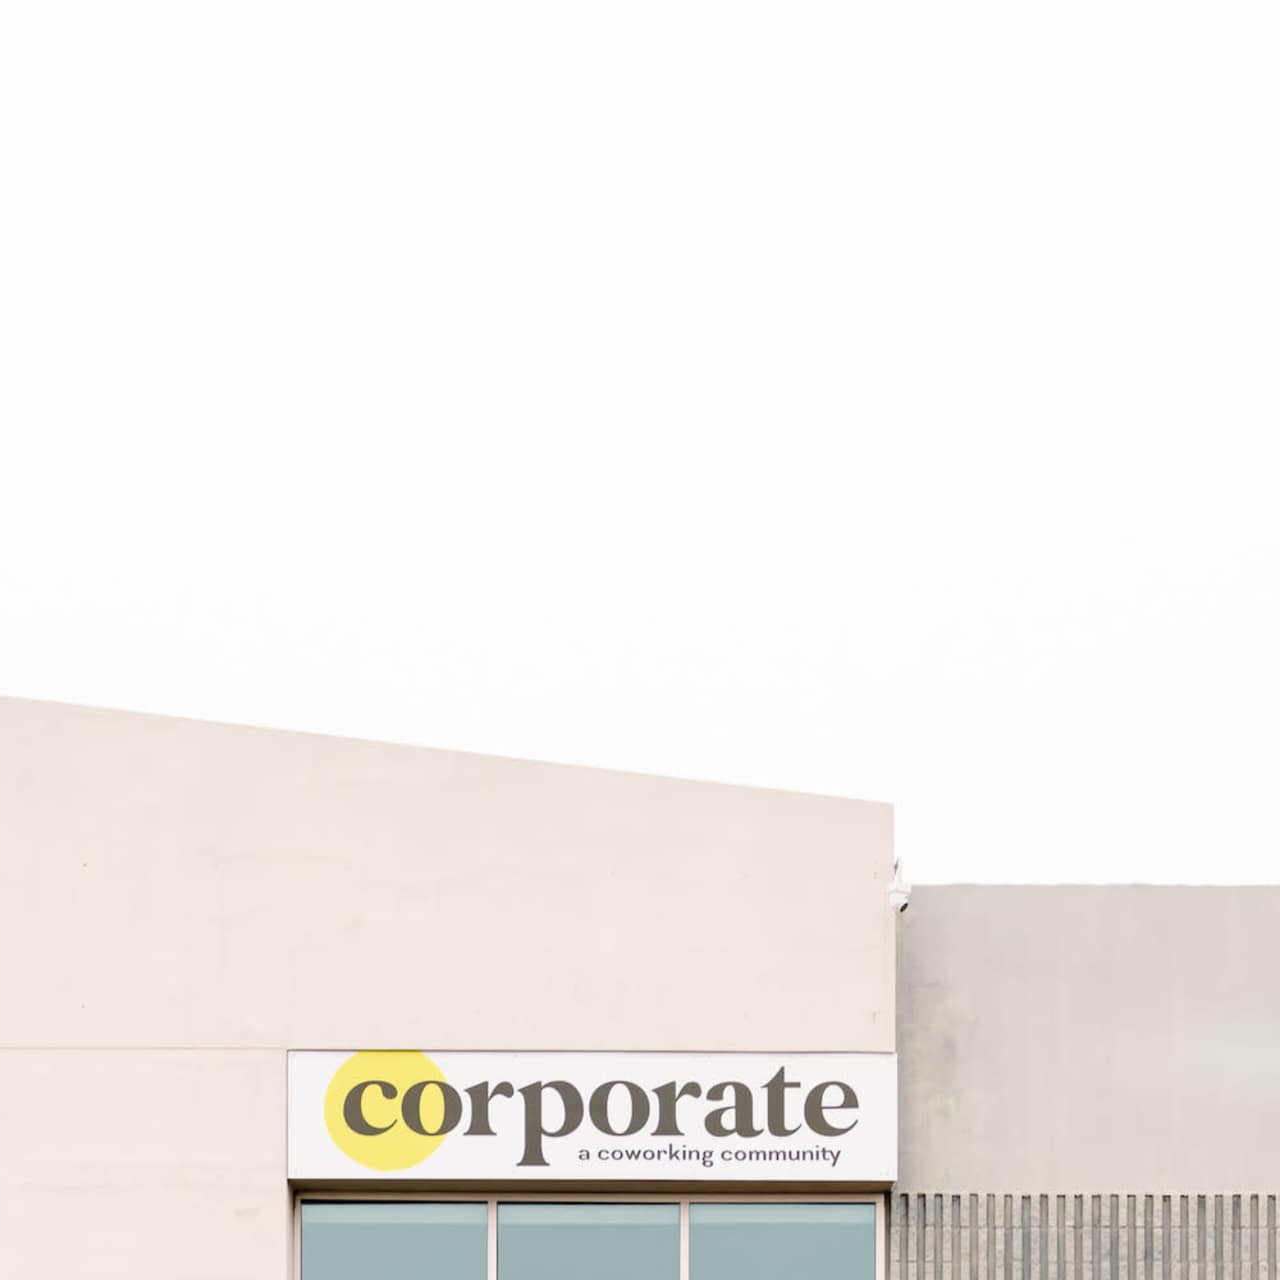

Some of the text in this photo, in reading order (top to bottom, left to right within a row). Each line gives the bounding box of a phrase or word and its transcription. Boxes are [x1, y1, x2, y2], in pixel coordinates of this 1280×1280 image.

[343, 1066, 860, 1167] corporate
[579, 1143, 841, 1168] a coworking community
